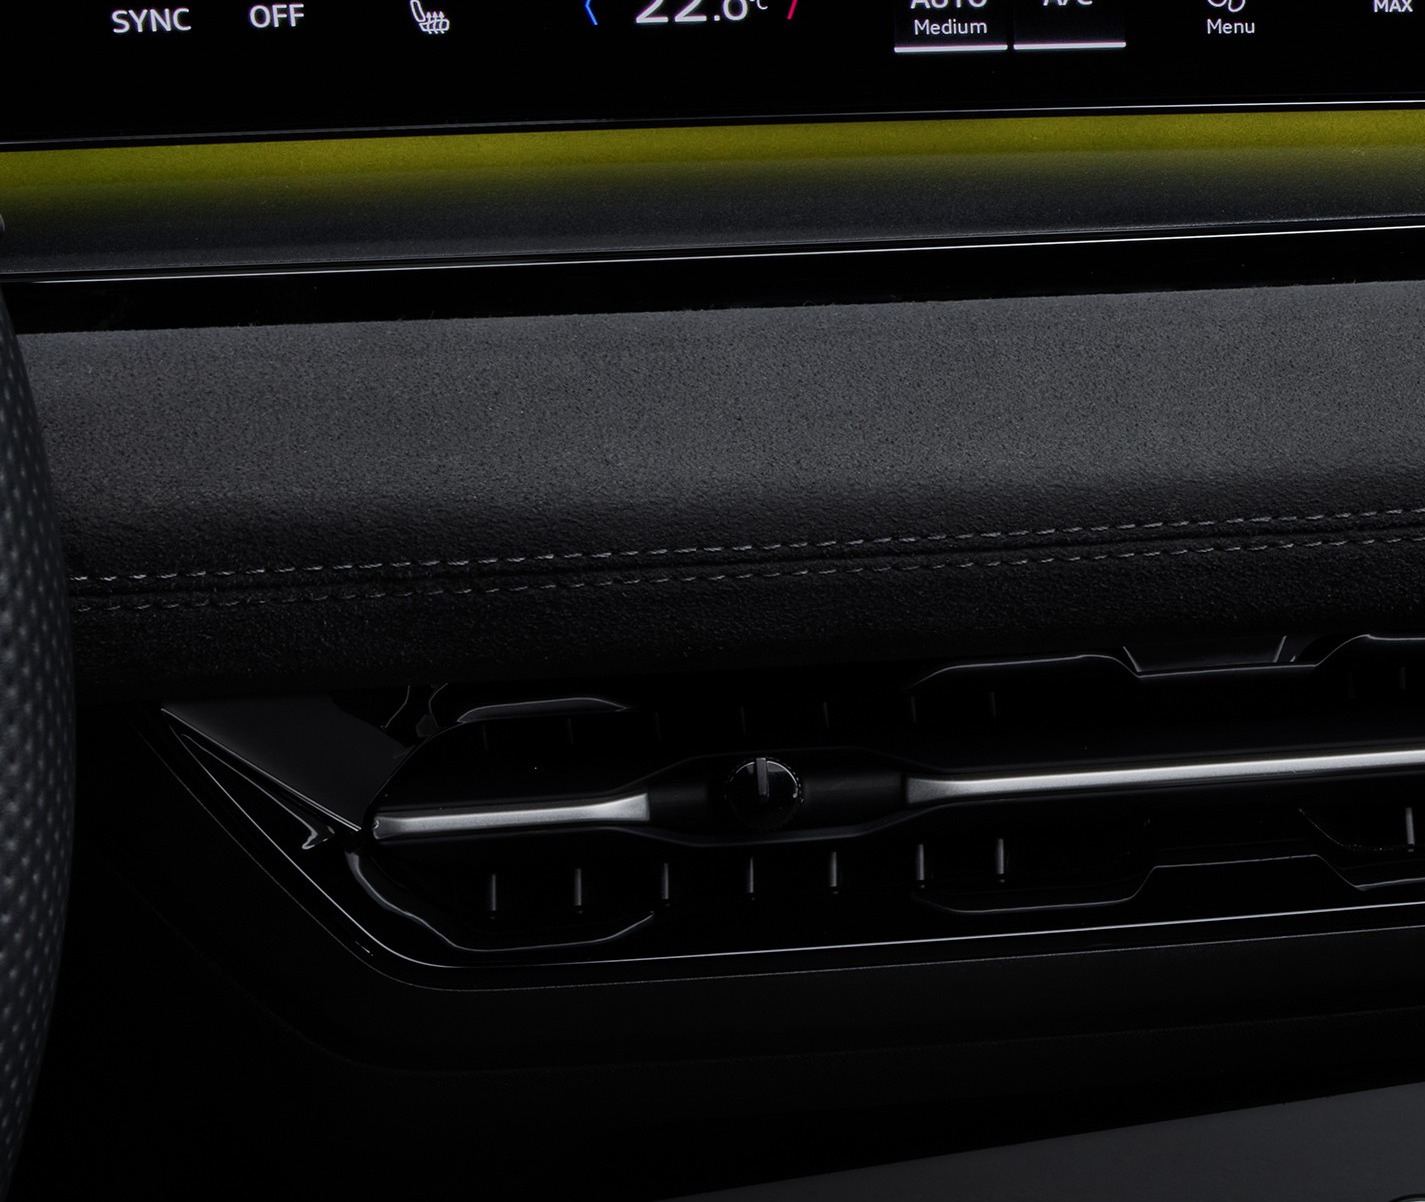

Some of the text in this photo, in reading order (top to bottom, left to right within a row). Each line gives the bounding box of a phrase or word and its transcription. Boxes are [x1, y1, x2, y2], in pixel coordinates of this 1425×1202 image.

[112, 8, 192, 34] SYNC
[249, 4, 305, 29] OFF
[914, 17, 988, 36] Medium
[1207, 18, 1255, 35] Menu
